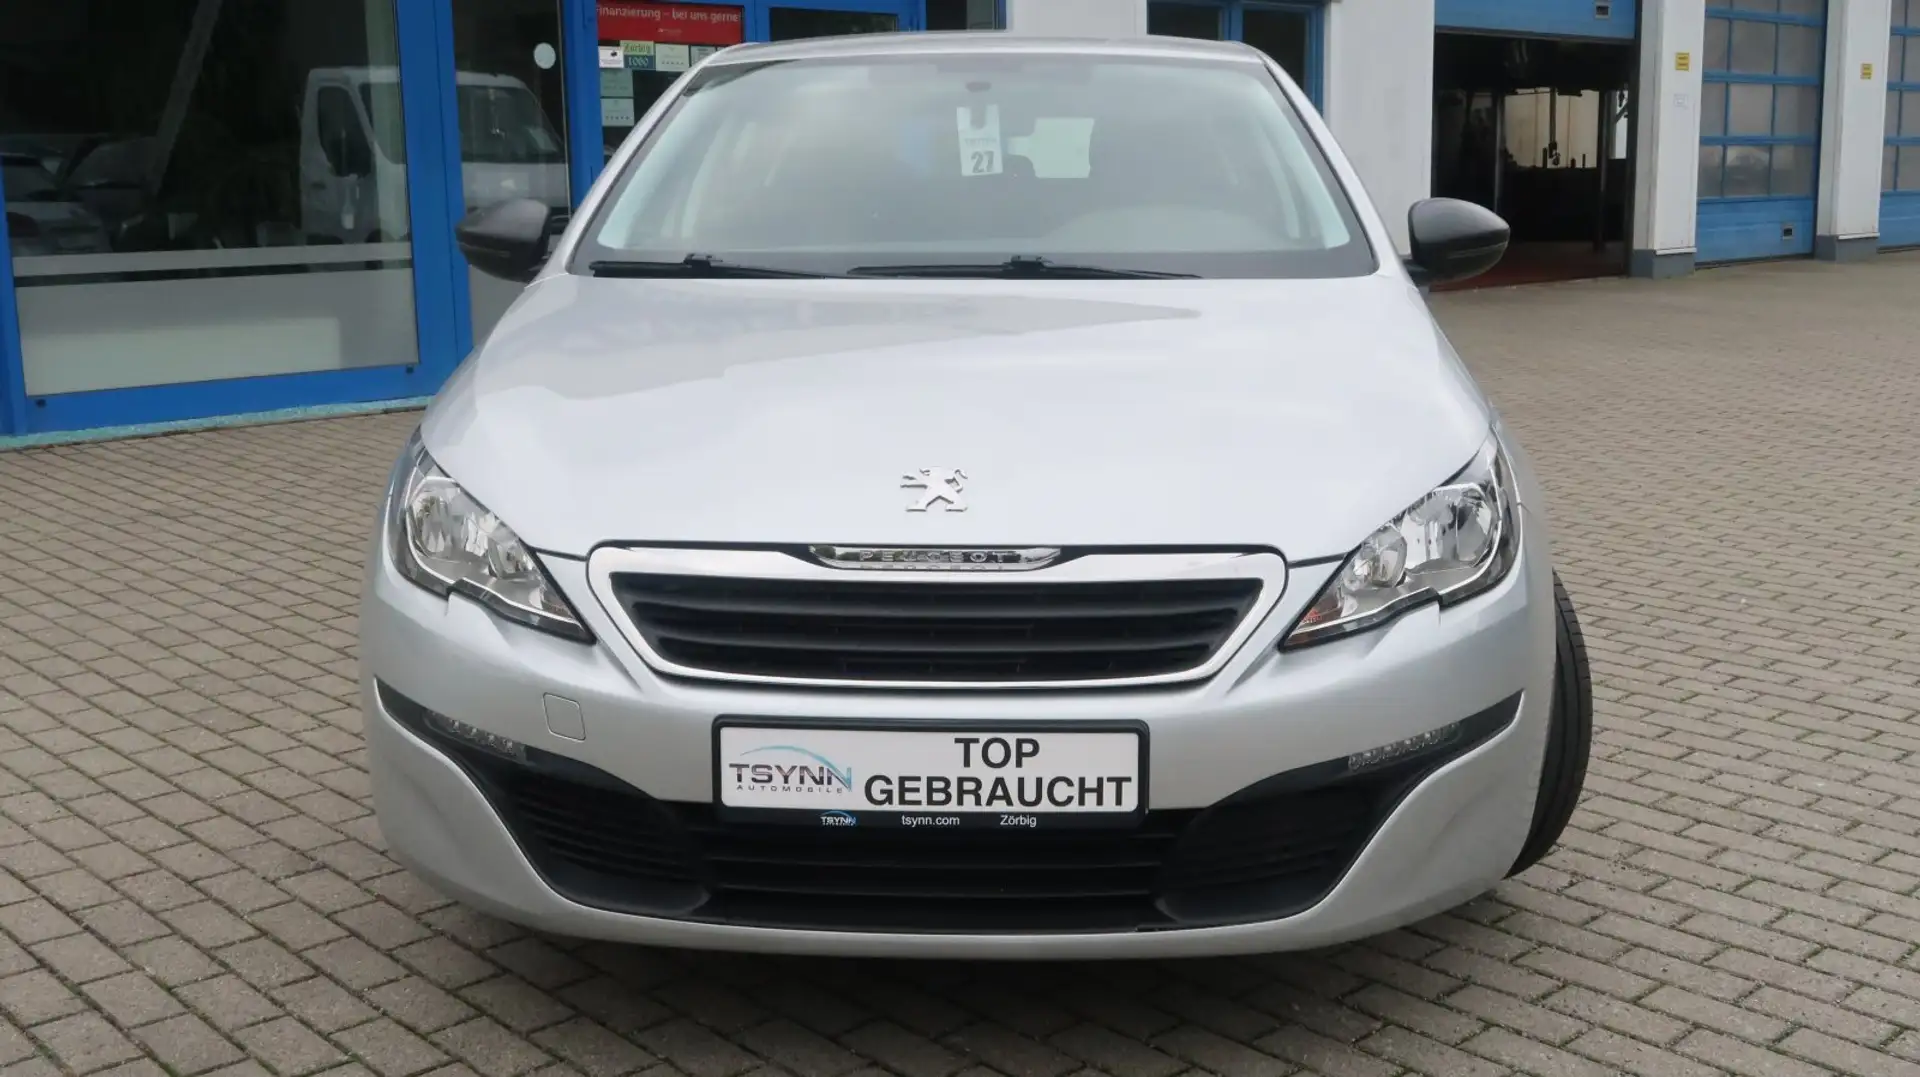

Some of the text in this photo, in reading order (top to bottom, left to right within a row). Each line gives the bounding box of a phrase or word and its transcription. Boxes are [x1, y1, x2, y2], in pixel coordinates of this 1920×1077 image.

[671, 8, 687, 20] bei
[690, 11, 707, 21] uns
[970, 151, 995, 174] 27
[859, 550, 1014, 563] PEUGEOT
[954, 737, 1040, 769] TOP
[729, 763, 852, 792] TSYNN
[736, 784, 843, 794] AUTOMOBILE
[864, 776, 1132, 808] GEBRAUCHT
[901, 815, 960, 827] tsynn.com
[1000, 815, 1037, 827] Zörbig
